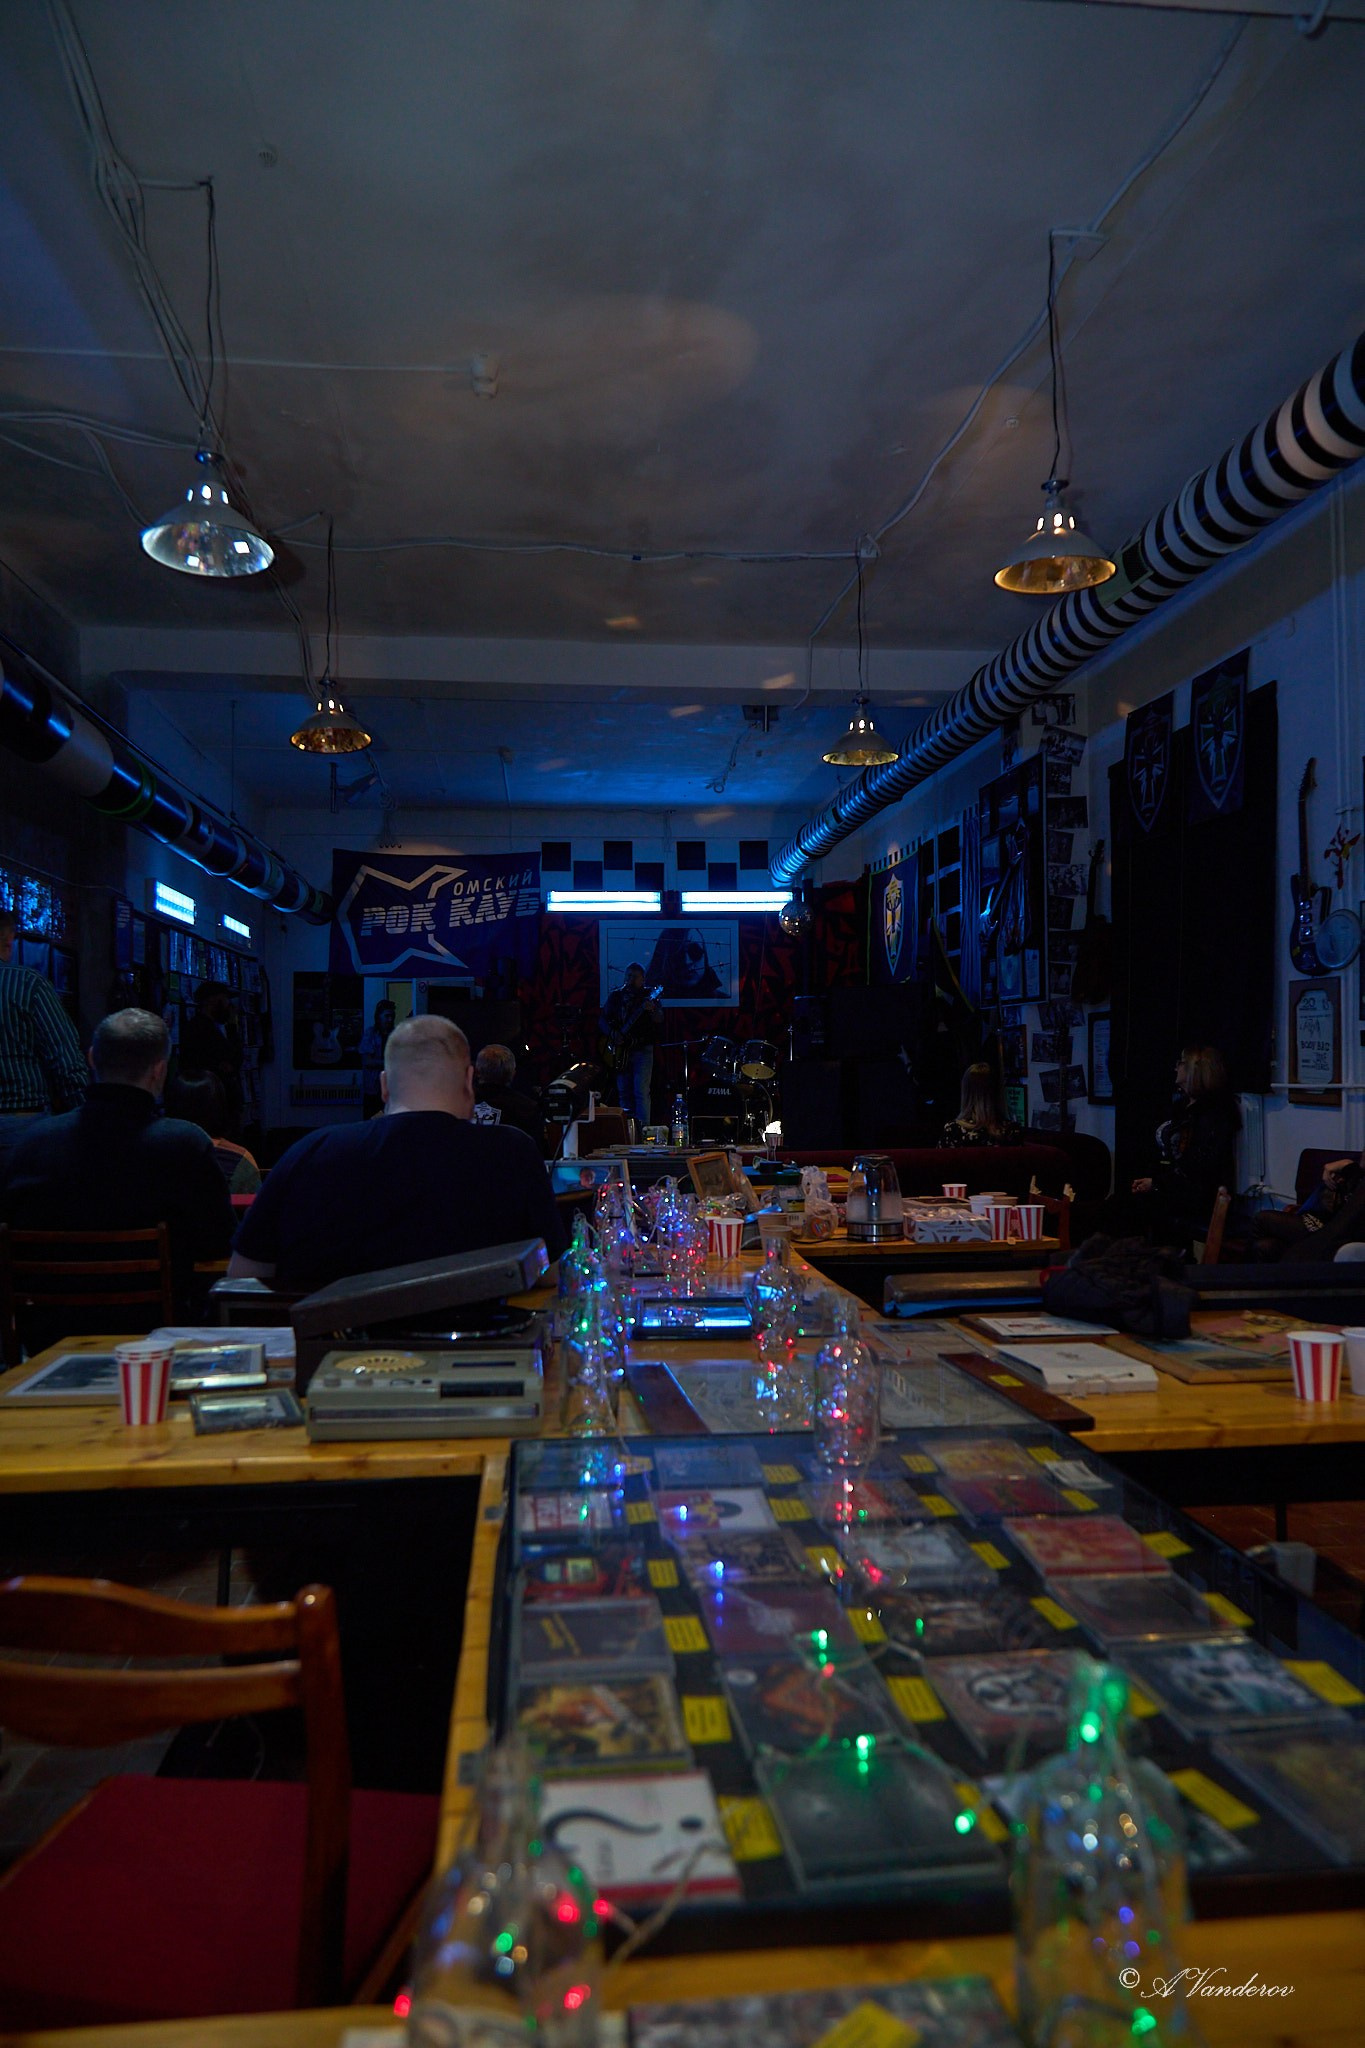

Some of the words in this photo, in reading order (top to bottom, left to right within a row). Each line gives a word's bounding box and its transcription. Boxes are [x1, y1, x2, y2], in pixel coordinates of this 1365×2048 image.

[452, 868, 534, 897] ОМСКИЙ
[360, 901, 437, 937] РОК
[448, 887, 541, 929] КЛУБ
